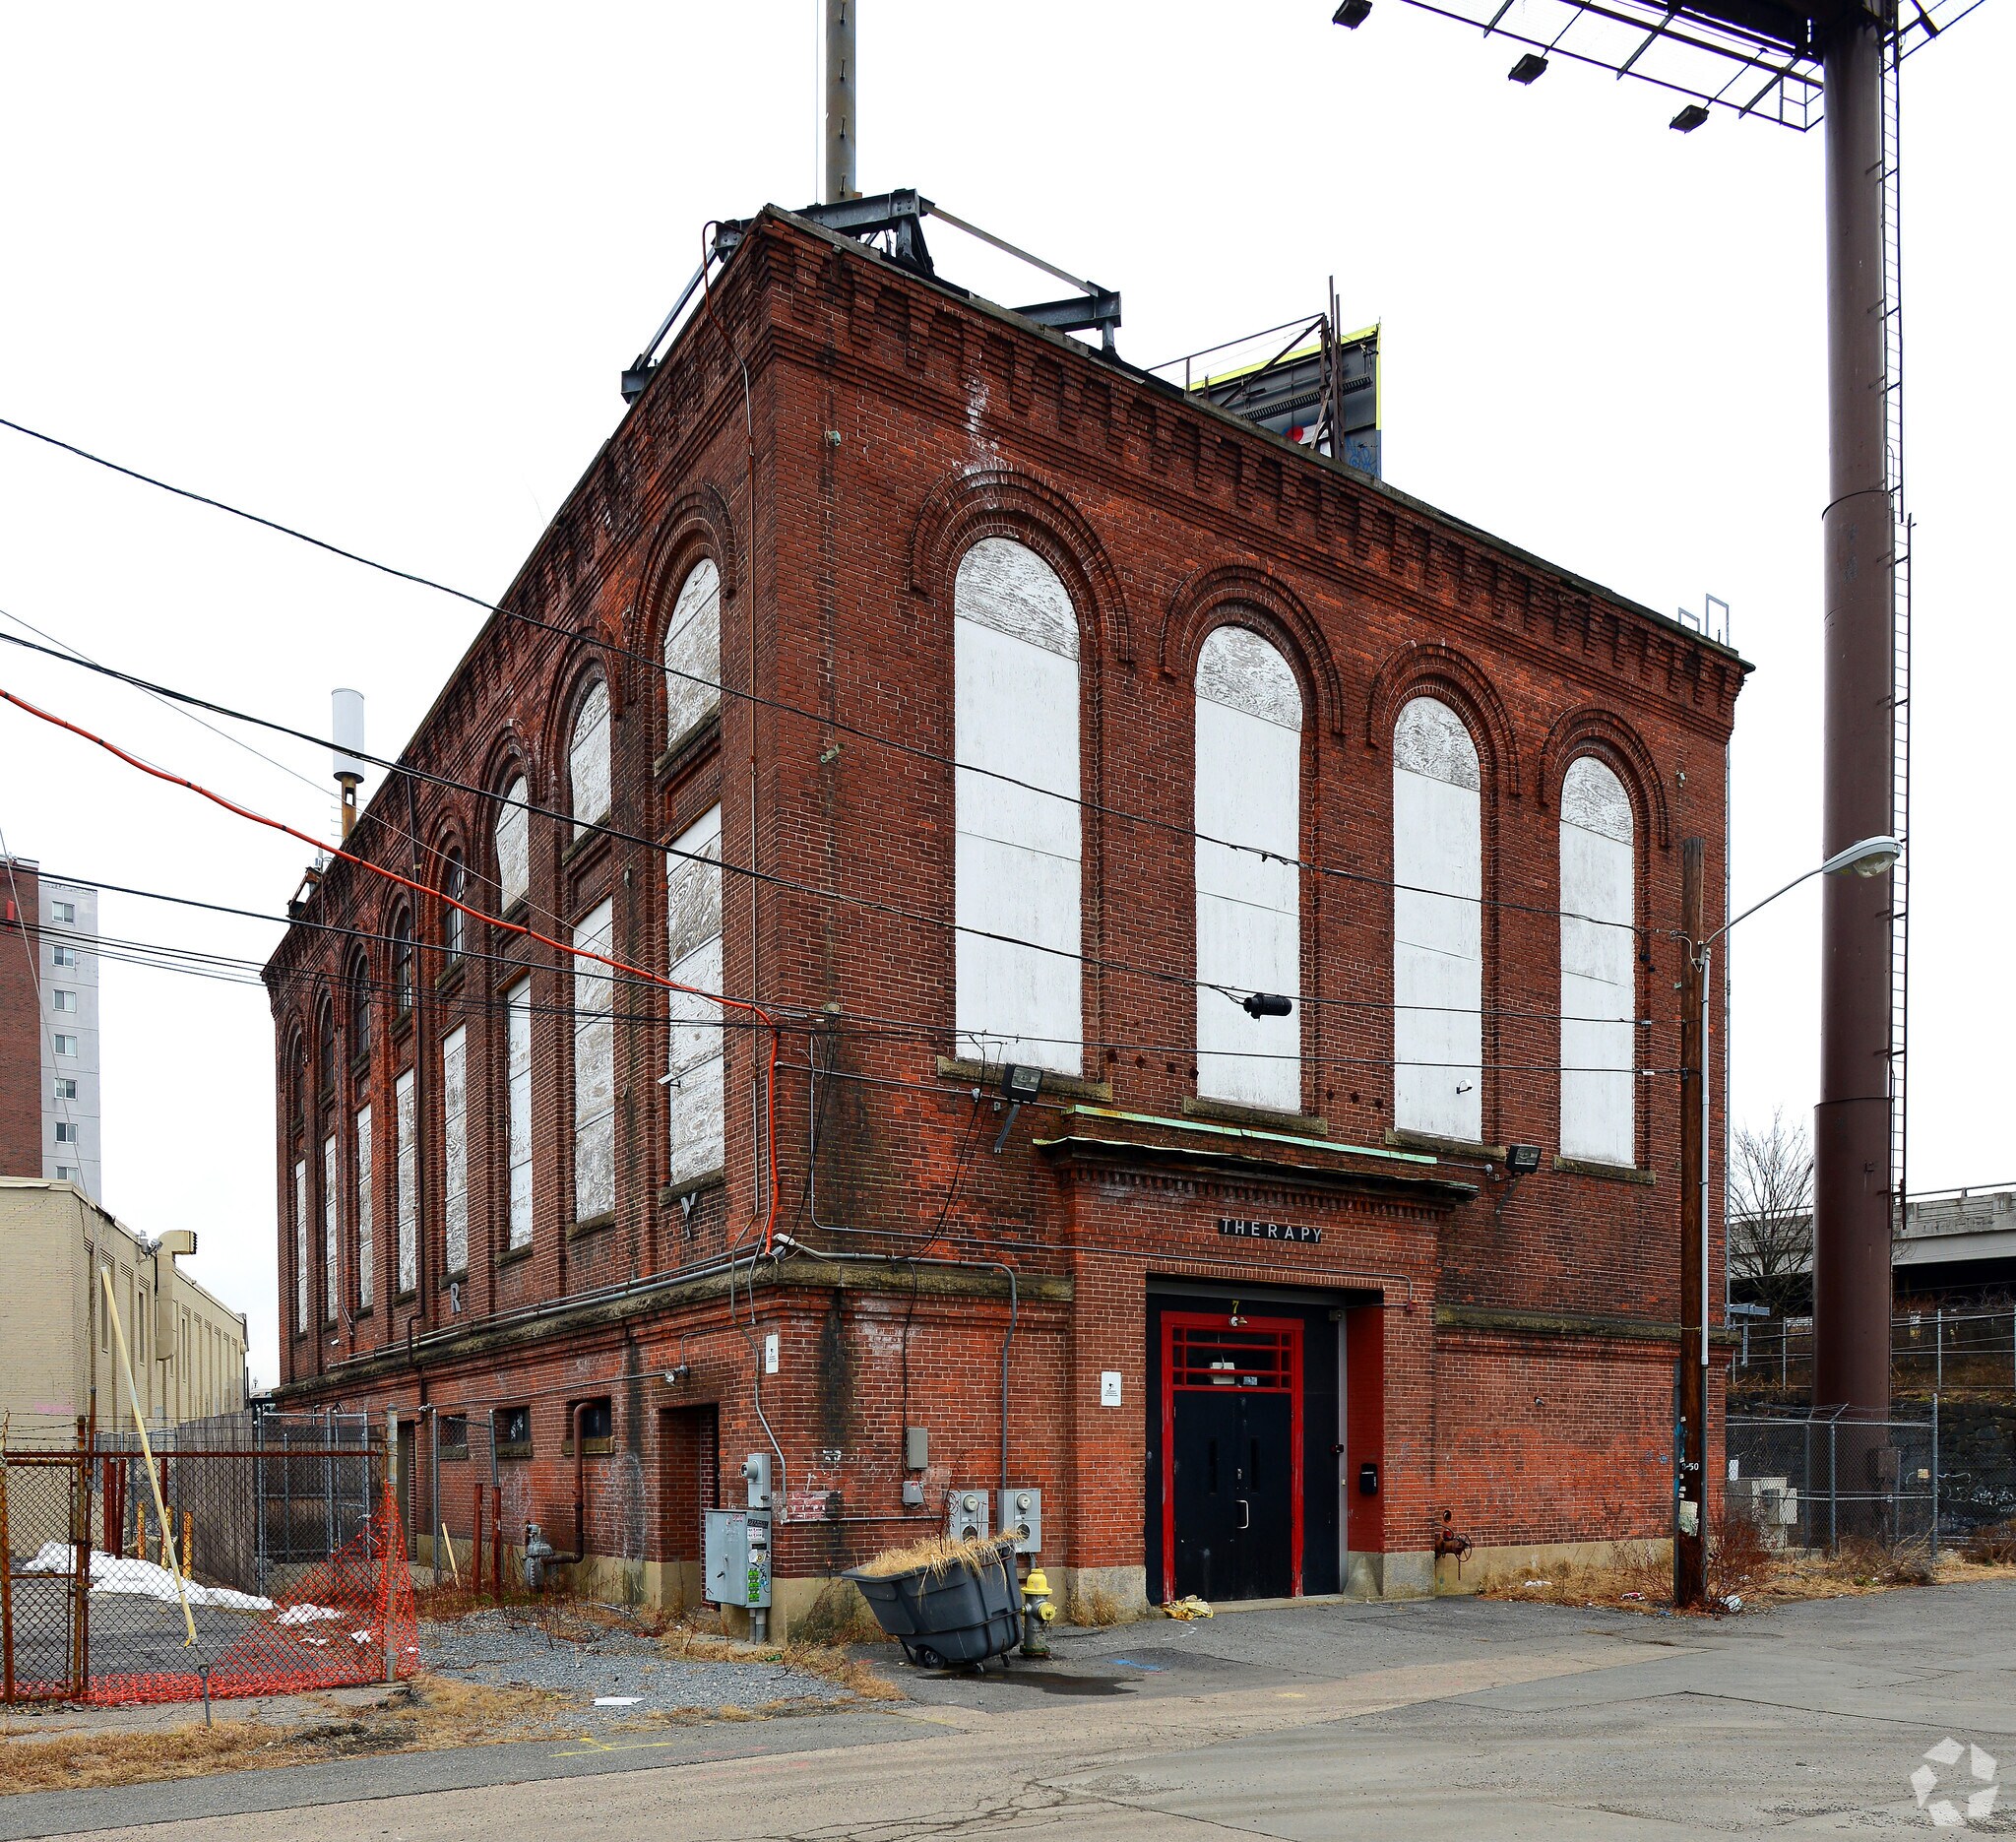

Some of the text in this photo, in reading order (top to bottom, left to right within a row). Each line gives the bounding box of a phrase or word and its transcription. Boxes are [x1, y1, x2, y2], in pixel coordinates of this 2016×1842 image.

[1222, 1218, 1322, 1242] THERAPY
[450, 1282, 462, 1313] R
[1232, 1301, 1239, 1314] 7
